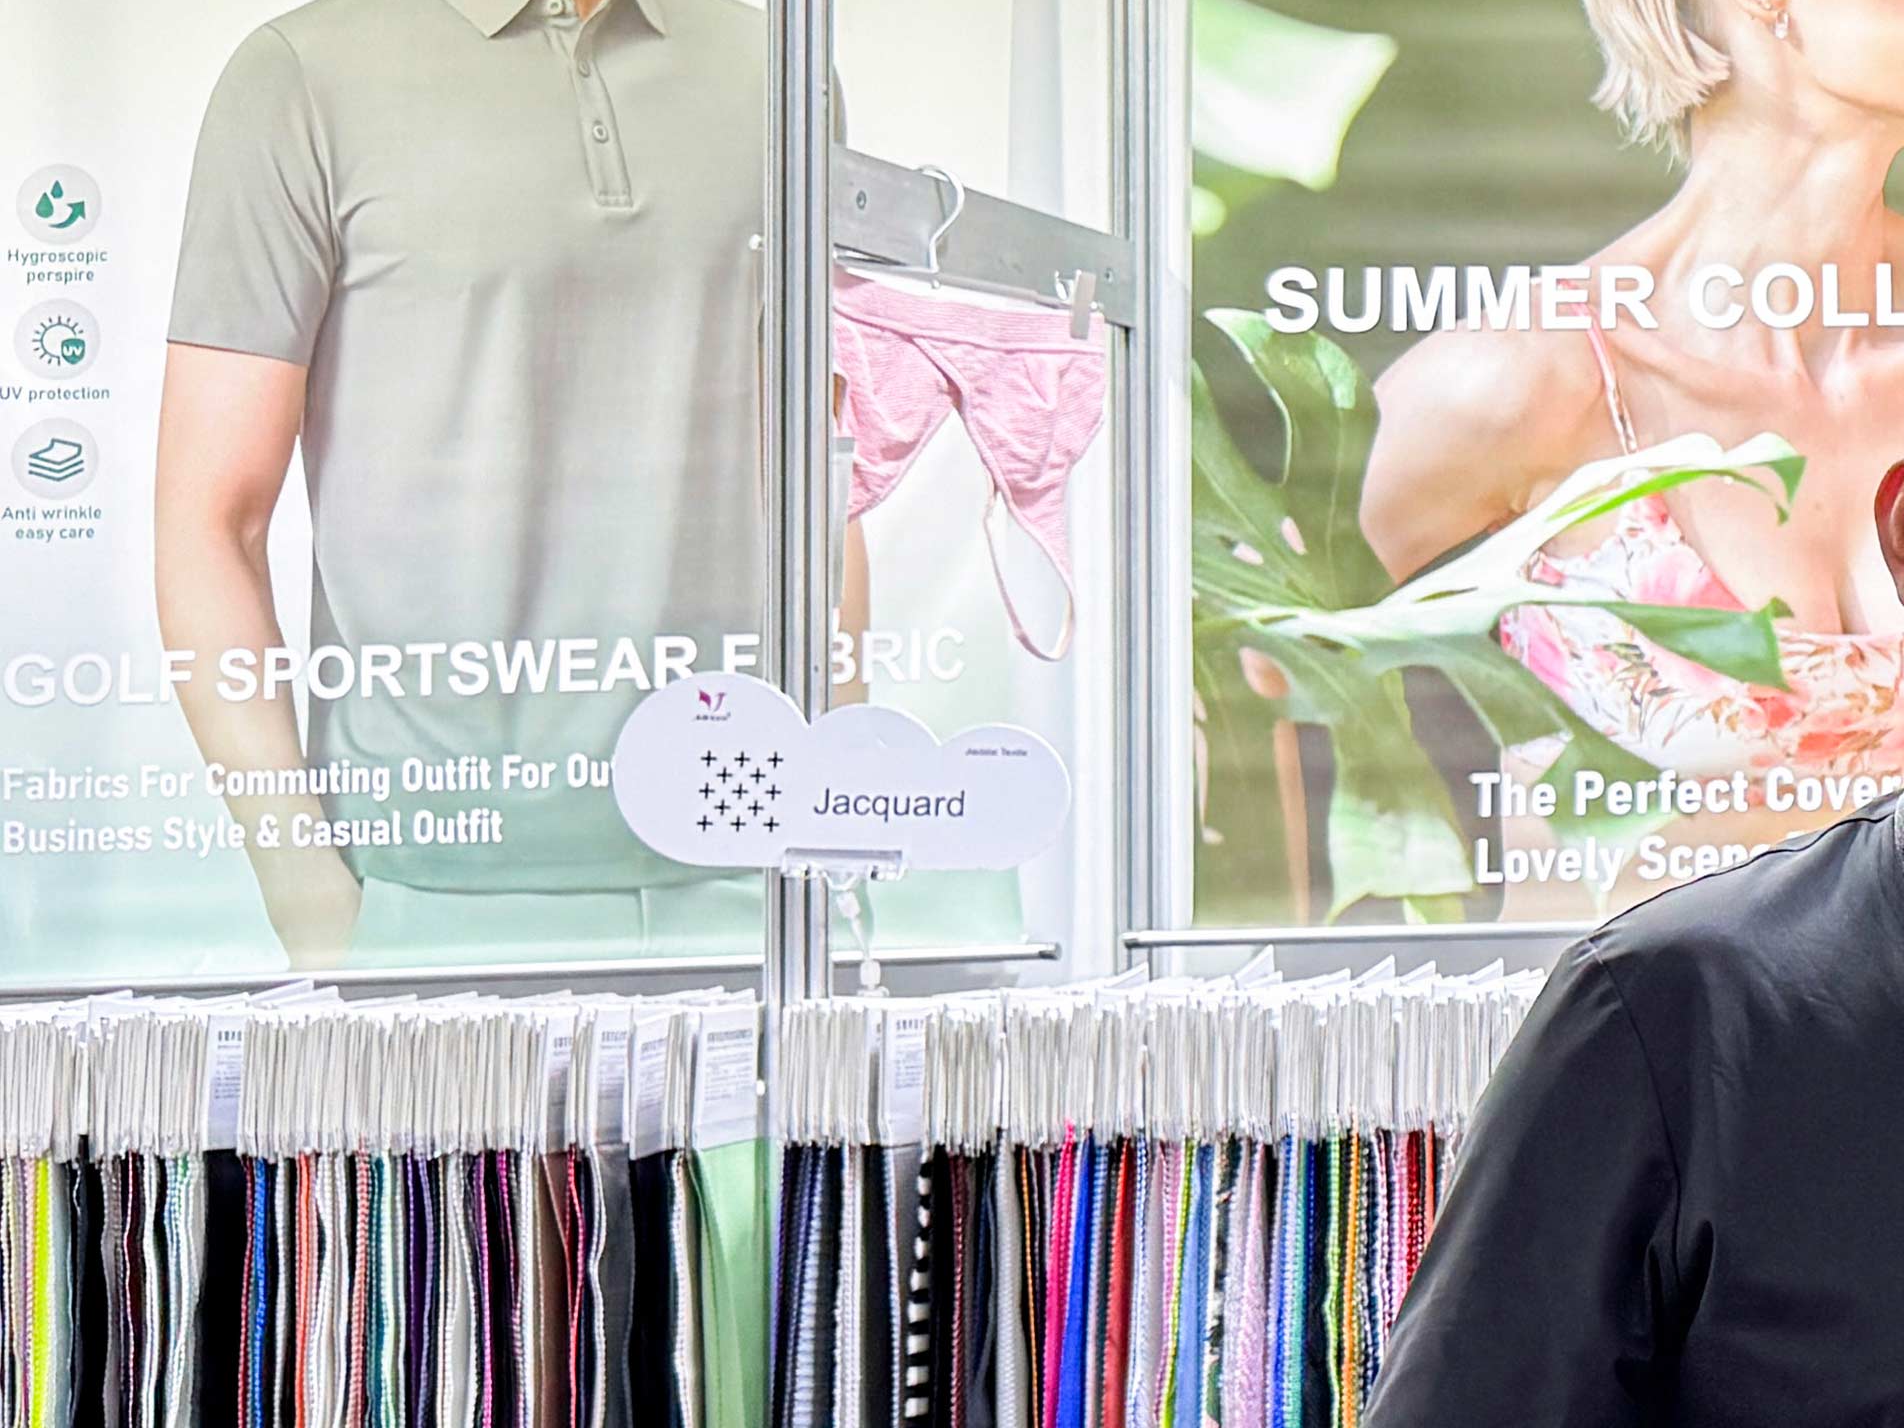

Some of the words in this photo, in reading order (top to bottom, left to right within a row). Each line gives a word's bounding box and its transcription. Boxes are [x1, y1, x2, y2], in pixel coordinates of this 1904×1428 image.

[7, 248, 109, 267] Hygroscopic
[25, 266, 95, 284] perspire
[1264, 264, 1659, 334] SUMMER
[28, 384, 110, 404] protection
[1, 505, 36, 521] Anti
[42, 505, 103, 521] wrinkle
[15, 526, 54, 543] easy
[59, 526, 96, 541] care
[3, 650, 197, 707] GOLF
[215, 633, 698, 702] SPORTSWEAR
[2, 763, 130, 802] Fabrics
[140, 763, 194, 799] For
[204, 759, 391, 804] Commuting
[402, 753, 492, 794] Outfit
[503, 754, 558, 789] For
[1468, 770, 1557, 818] The
[1574, 766, 1749, 817] Perfect
[812, 787, 966, 824] Jacquard
[3, 817, 153, 854] Business
[162, 815, 244, 859] Style
[256, 816, 282, 849] &
[292, 810, 402, 849] Casual
[412, 807, 503, 844] Outfit
[1473, 835, 1626, 892] Lovely
